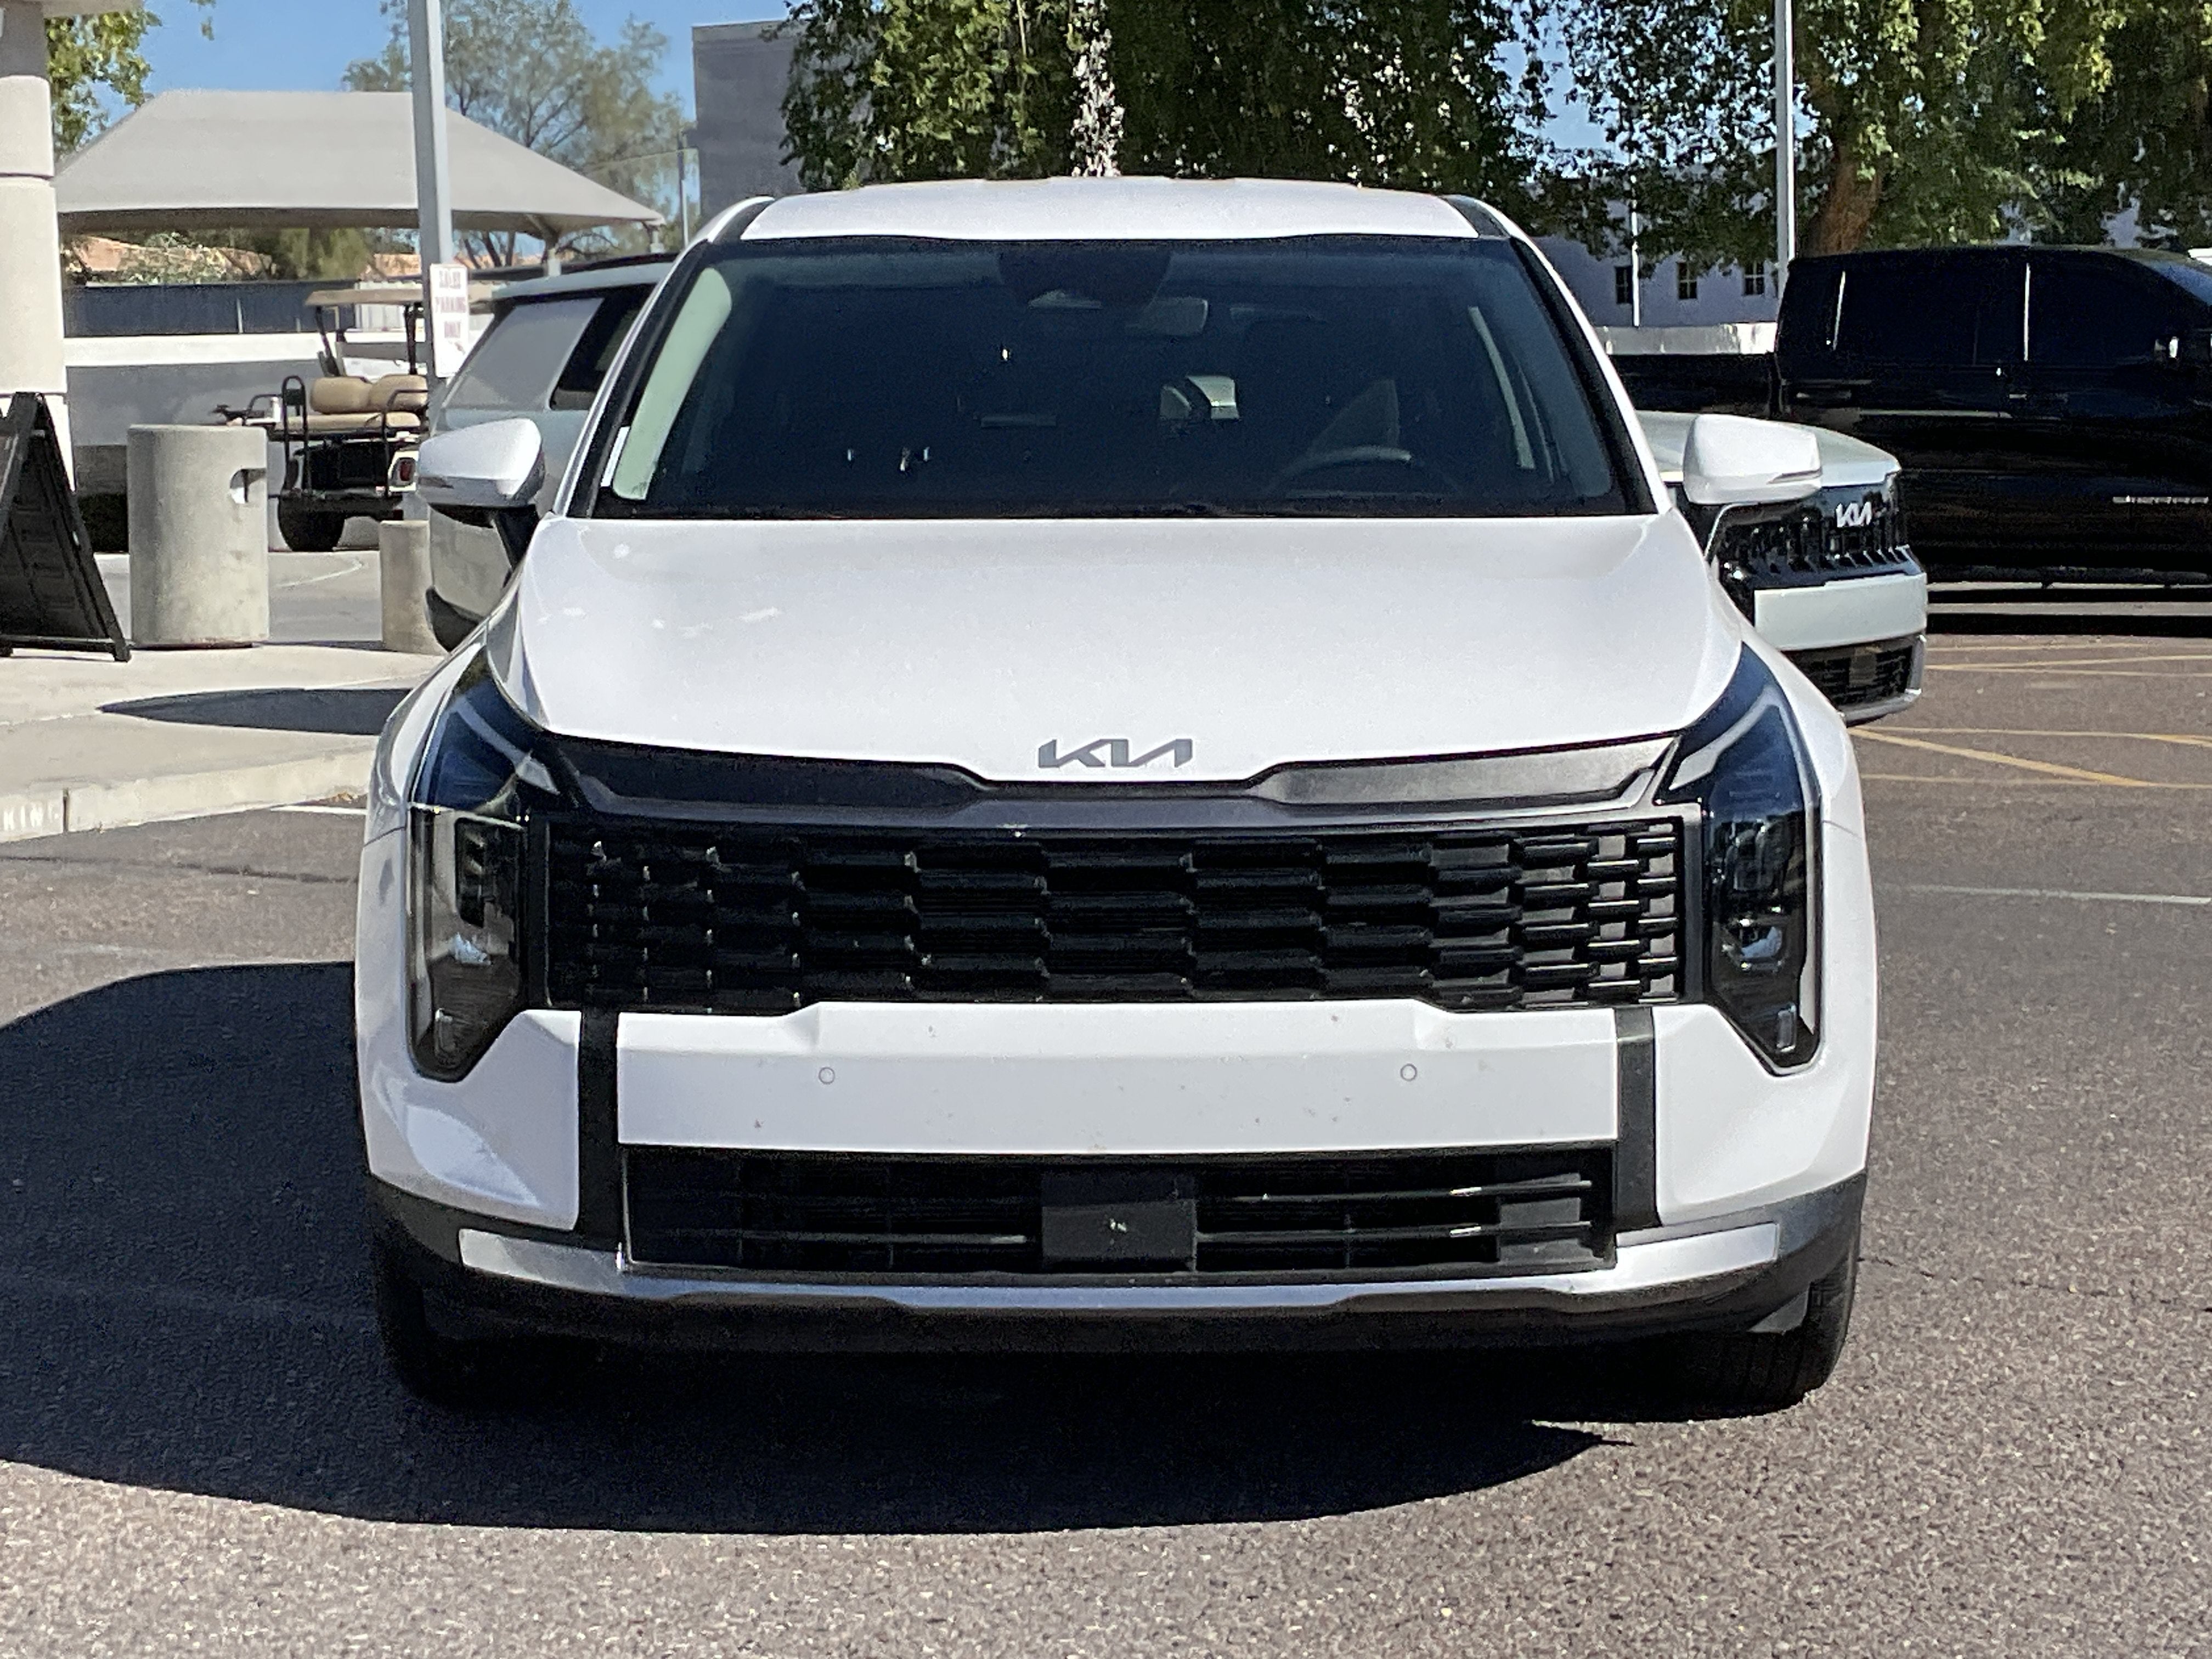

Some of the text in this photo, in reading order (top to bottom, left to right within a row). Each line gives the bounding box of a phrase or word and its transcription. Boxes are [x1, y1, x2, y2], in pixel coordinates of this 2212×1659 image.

[435, 297, 466, 313] PARKING
[1836, 501, 1872, 528] KIA
[1039, 738, 1193, 769] KIA
